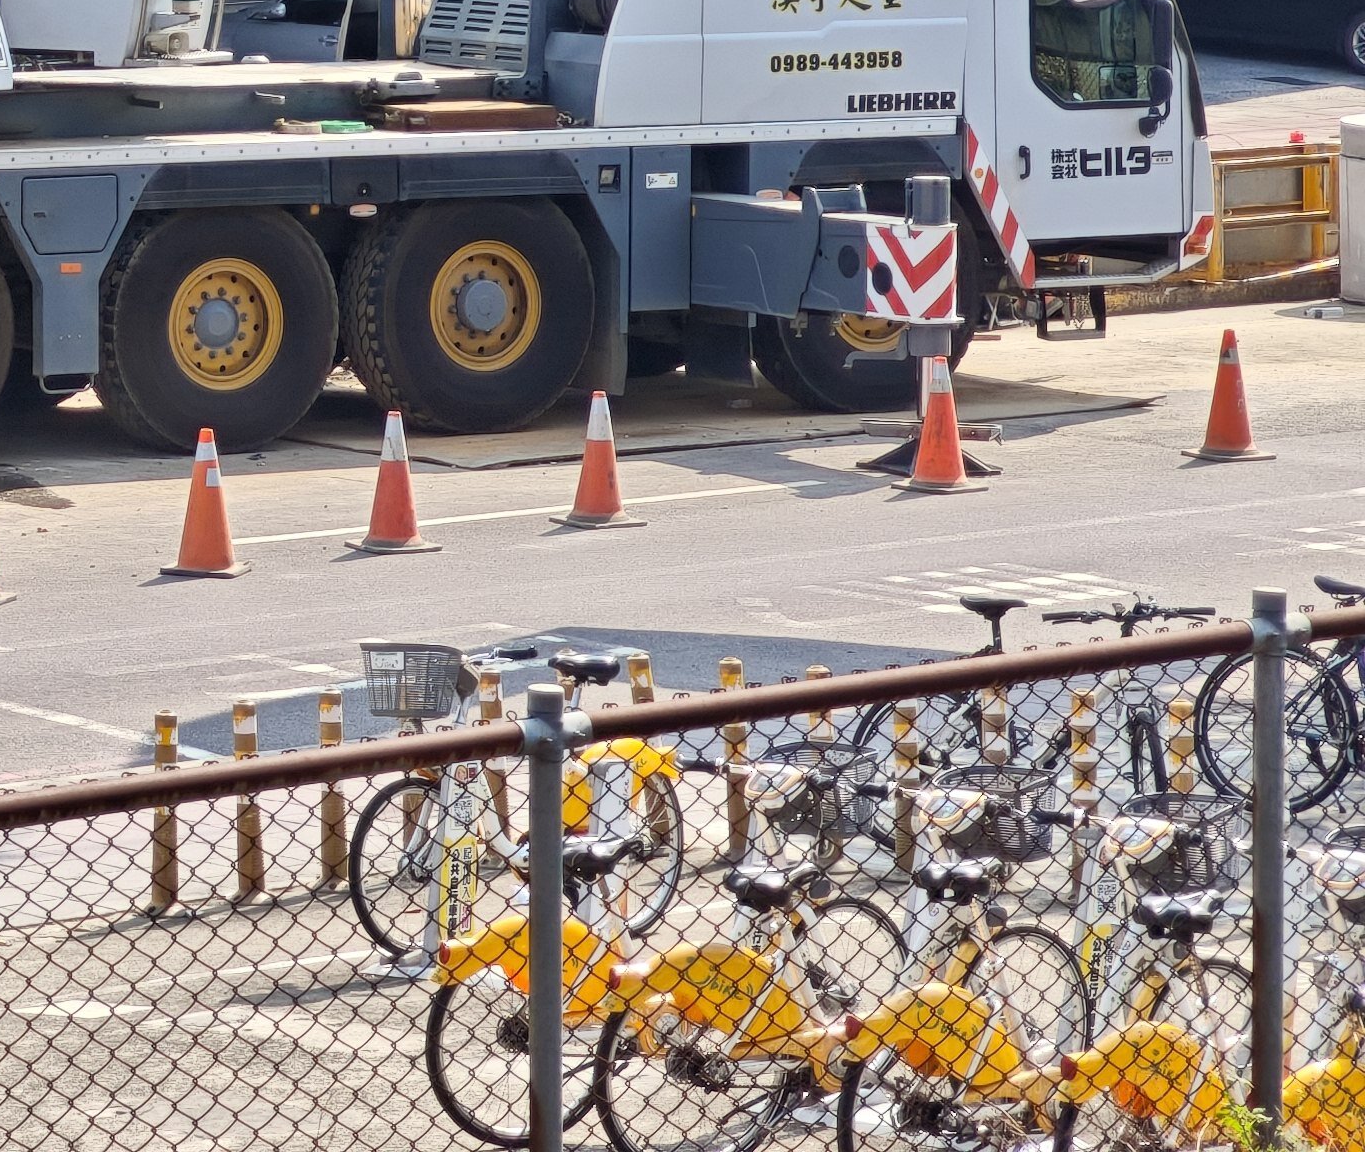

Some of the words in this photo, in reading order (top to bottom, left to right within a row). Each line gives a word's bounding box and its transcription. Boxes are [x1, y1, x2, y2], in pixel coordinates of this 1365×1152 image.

[770, 50, 903, 73] 0989-443958
[847, 91, 957, 113] LIEBHERR
[1079, 145, 1151, 178] ヒルタ
